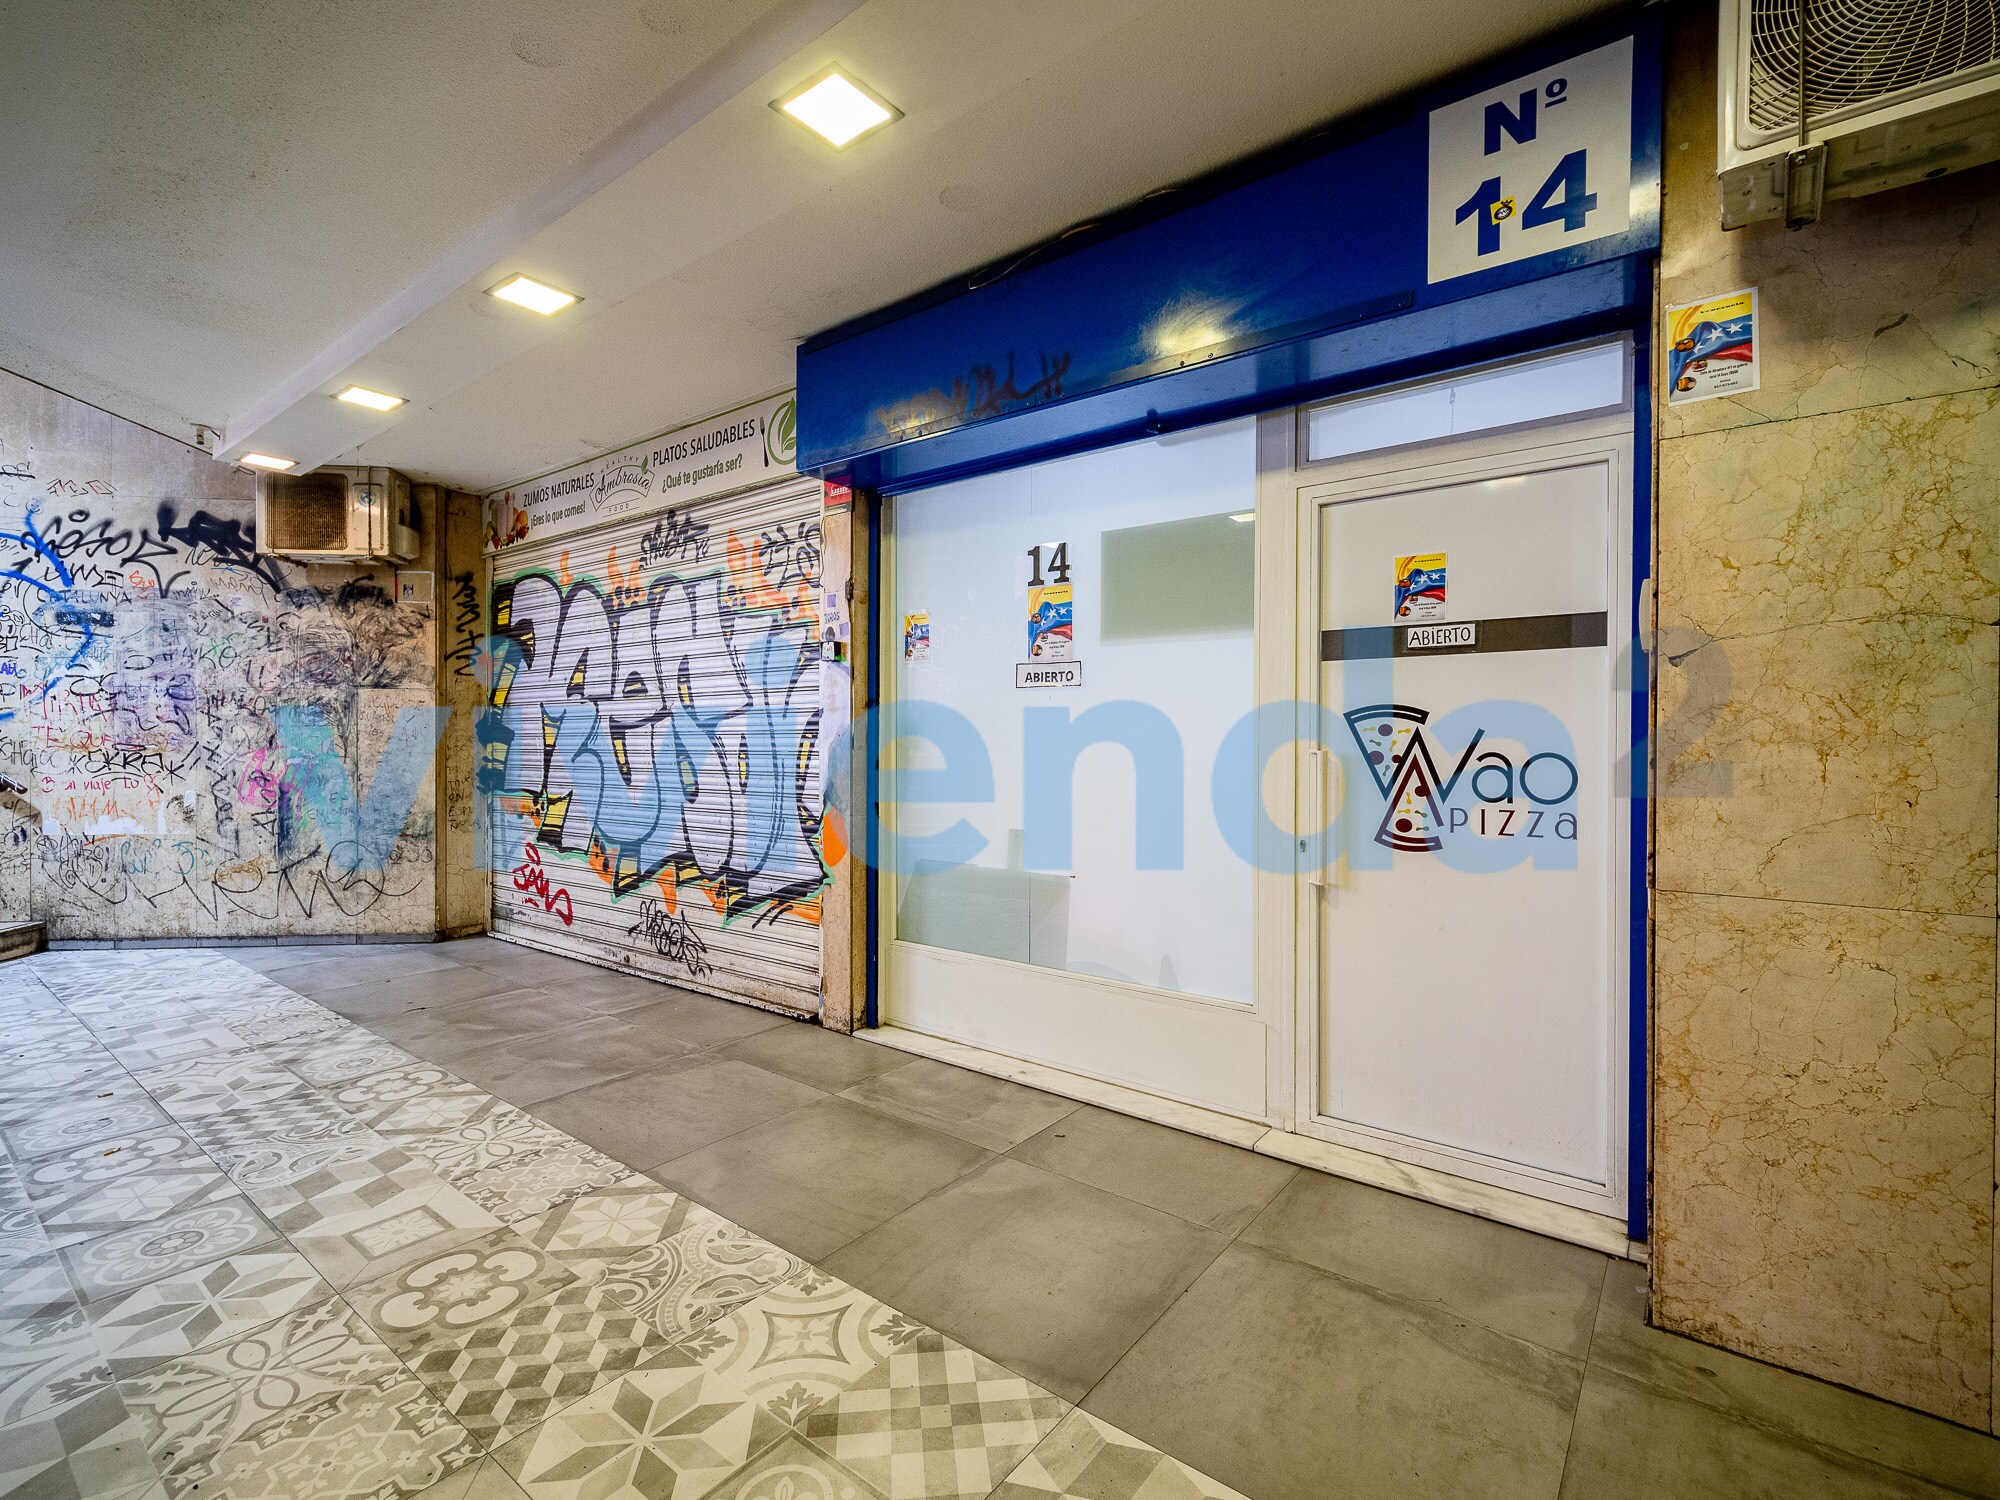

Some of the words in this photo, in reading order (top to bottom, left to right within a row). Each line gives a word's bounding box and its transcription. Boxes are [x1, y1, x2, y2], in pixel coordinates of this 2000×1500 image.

[1455, 148, 1598, 258] 14
[653, 441, 688, 467] PLATOS
[690, 418, 755, 456] SALUDABLES
[600, 455, 639, 475] HEALTHY
[662, 470, 682, 494] ¿Qué
[683, 470, 691, 485] te
[692, 460, 724, 486] gustaría
[725, 453, 743, 472] ser?
[523, 486, 550, 508] ZUMOS
[551, 472, 595, 500] NATURALES
[608, 502, 630, 514] FOOD
[530, 514, 545, 530] ¡Eres
[545, 510, 551, 524] lo
[551, 508, 564, 525] que
[564, 500, 587, 519] comes!
[1027, 541, 1071, 587] 14
[1024, 670, 1074, 683] ABIERTO
